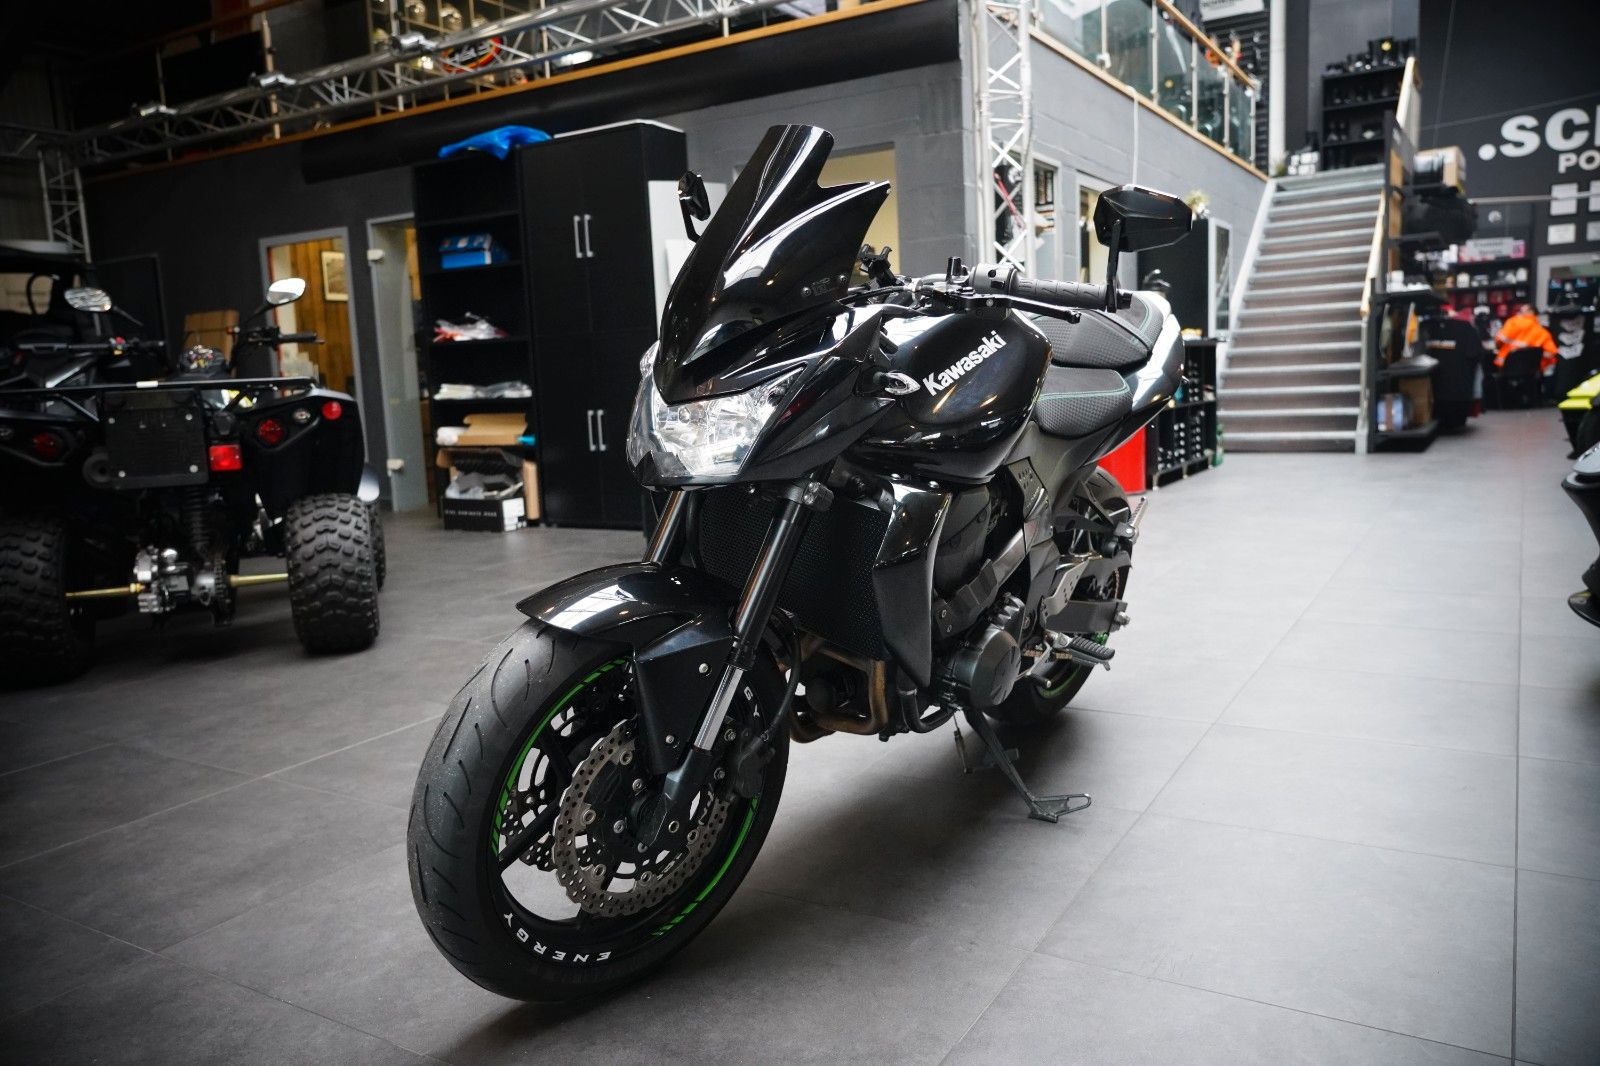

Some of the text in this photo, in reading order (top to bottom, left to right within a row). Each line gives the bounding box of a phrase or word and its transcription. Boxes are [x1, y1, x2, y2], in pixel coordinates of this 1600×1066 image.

[1478, 105, 1600, 160] .SC
[922, 330, 1007, 396] Kawasaki
[503, 912, 612, 963] ENERGY
